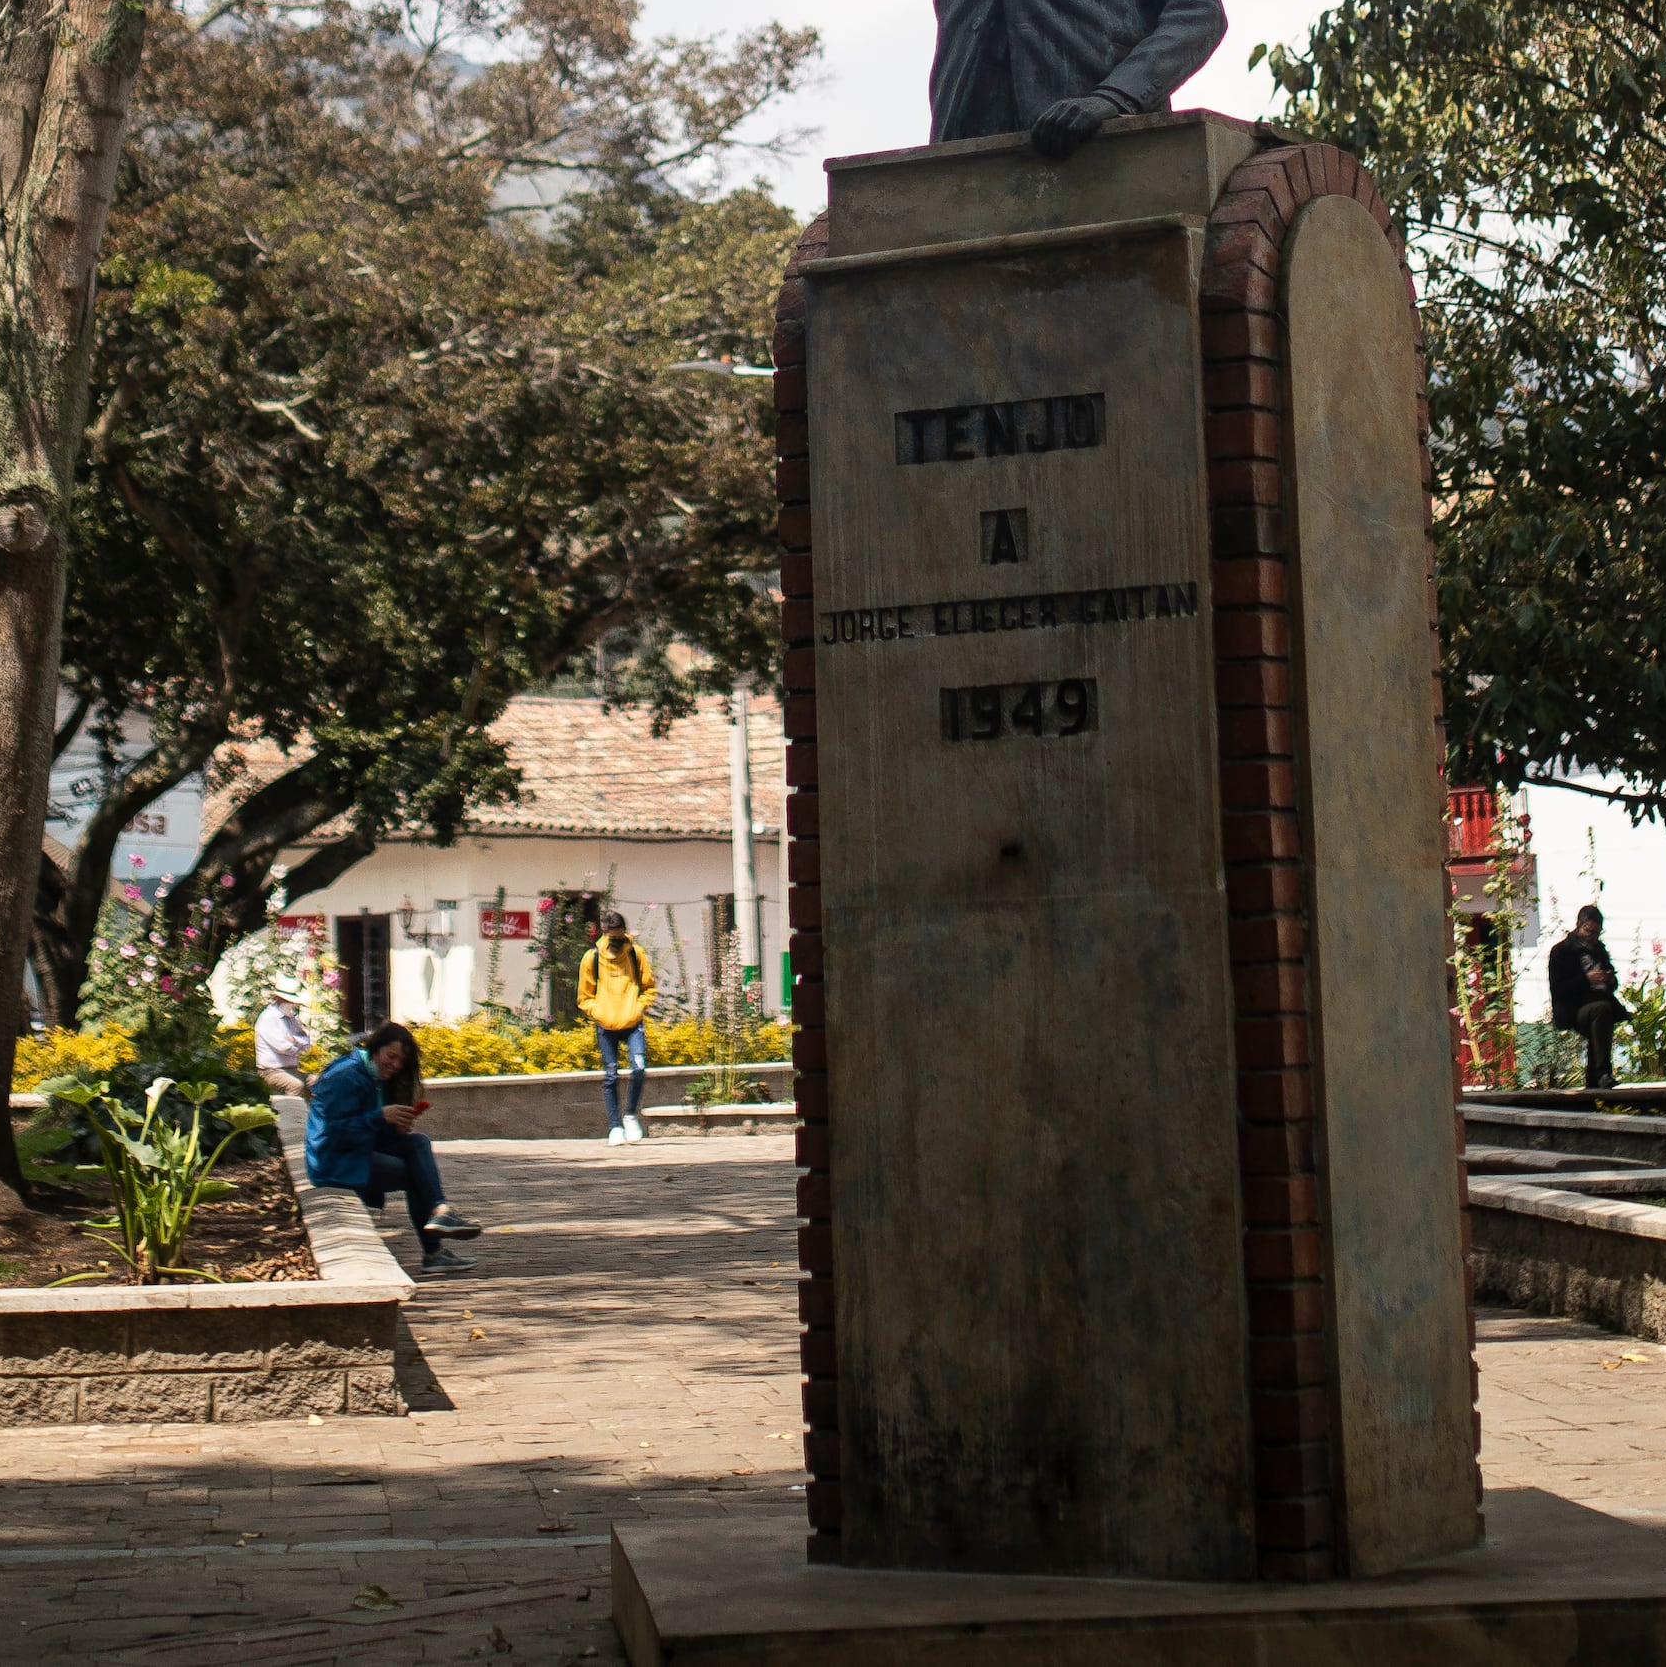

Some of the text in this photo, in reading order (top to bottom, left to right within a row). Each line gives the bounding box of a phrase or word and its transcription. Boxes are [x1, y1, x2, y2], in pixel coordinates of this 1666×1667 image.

[903, 394, 1101, 464] TENJO
[990, 508, 1020, 564] A
[823, 582, 1197, 644] JORGE ELIECER GAITAN
[950, 678, 1089, 741] 1949
